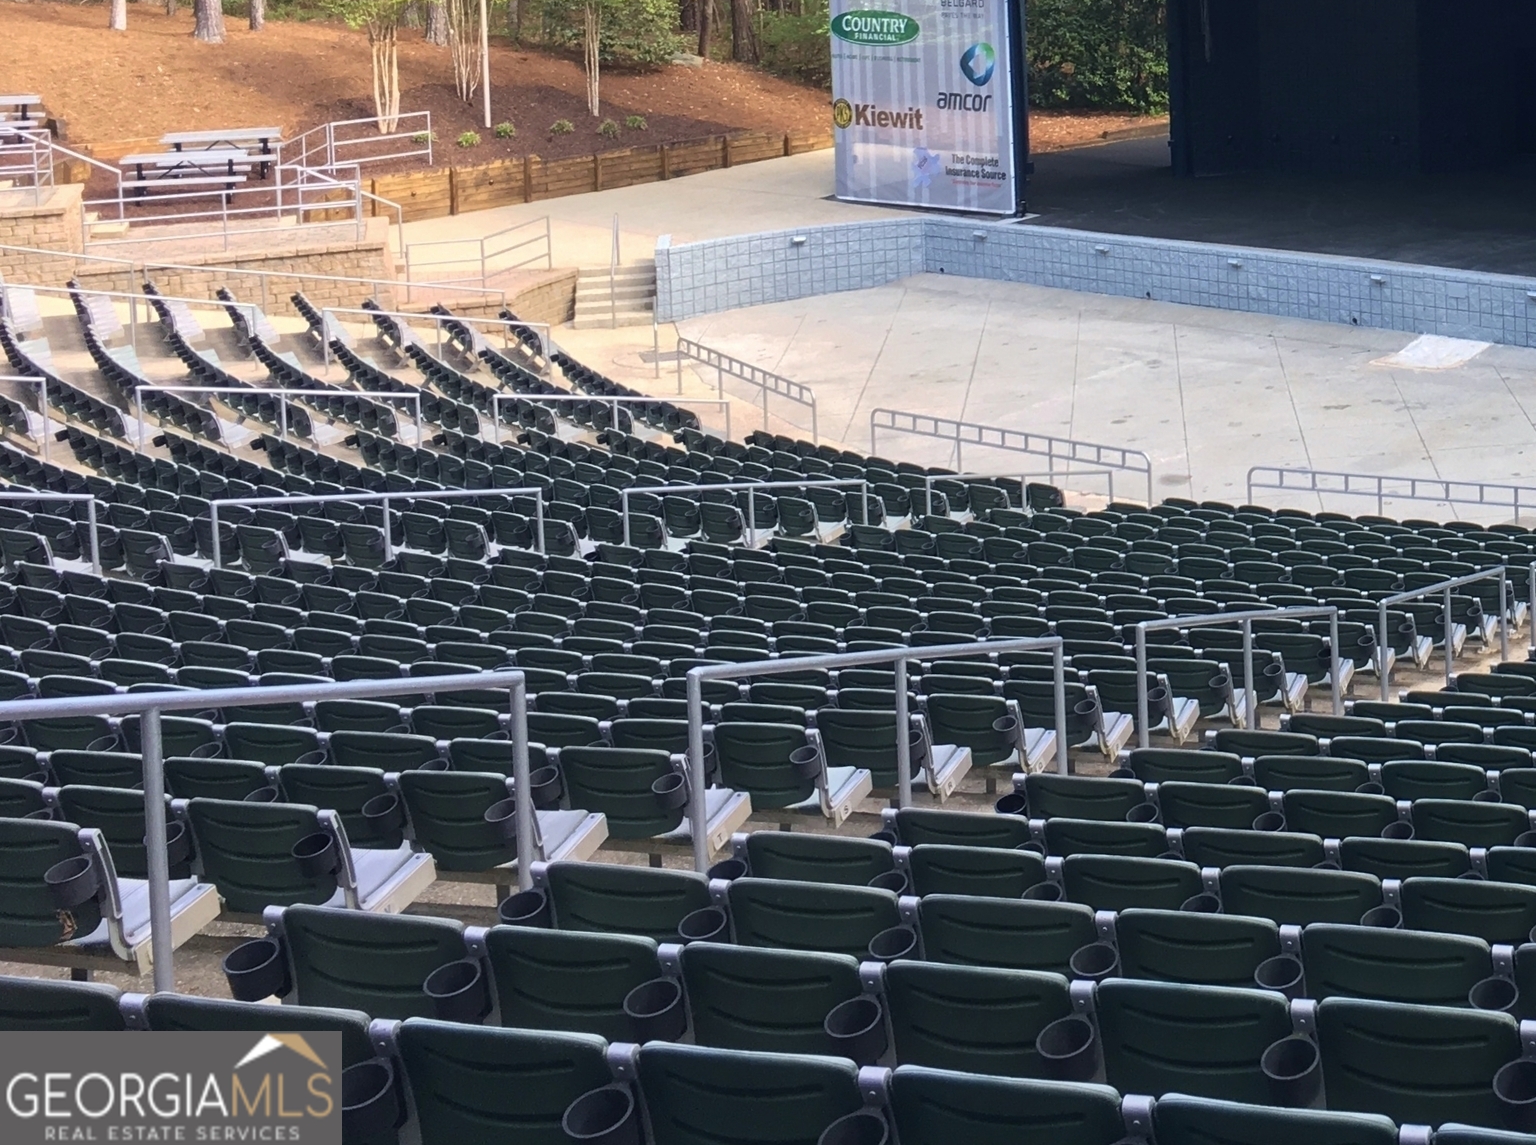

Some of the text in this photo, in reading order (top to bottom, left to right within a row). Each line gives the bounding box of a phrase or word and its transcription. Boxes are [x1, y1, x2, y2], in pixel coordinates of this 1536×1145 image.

[841, 15, 908, 34] COUNTRY
[936, 92, 993, 113] amcor
[854, 103, 924, 130] Kiewit
[951, 153, 999, 169] The Complete
[945, 165, 1007, 181] Insurance Source
